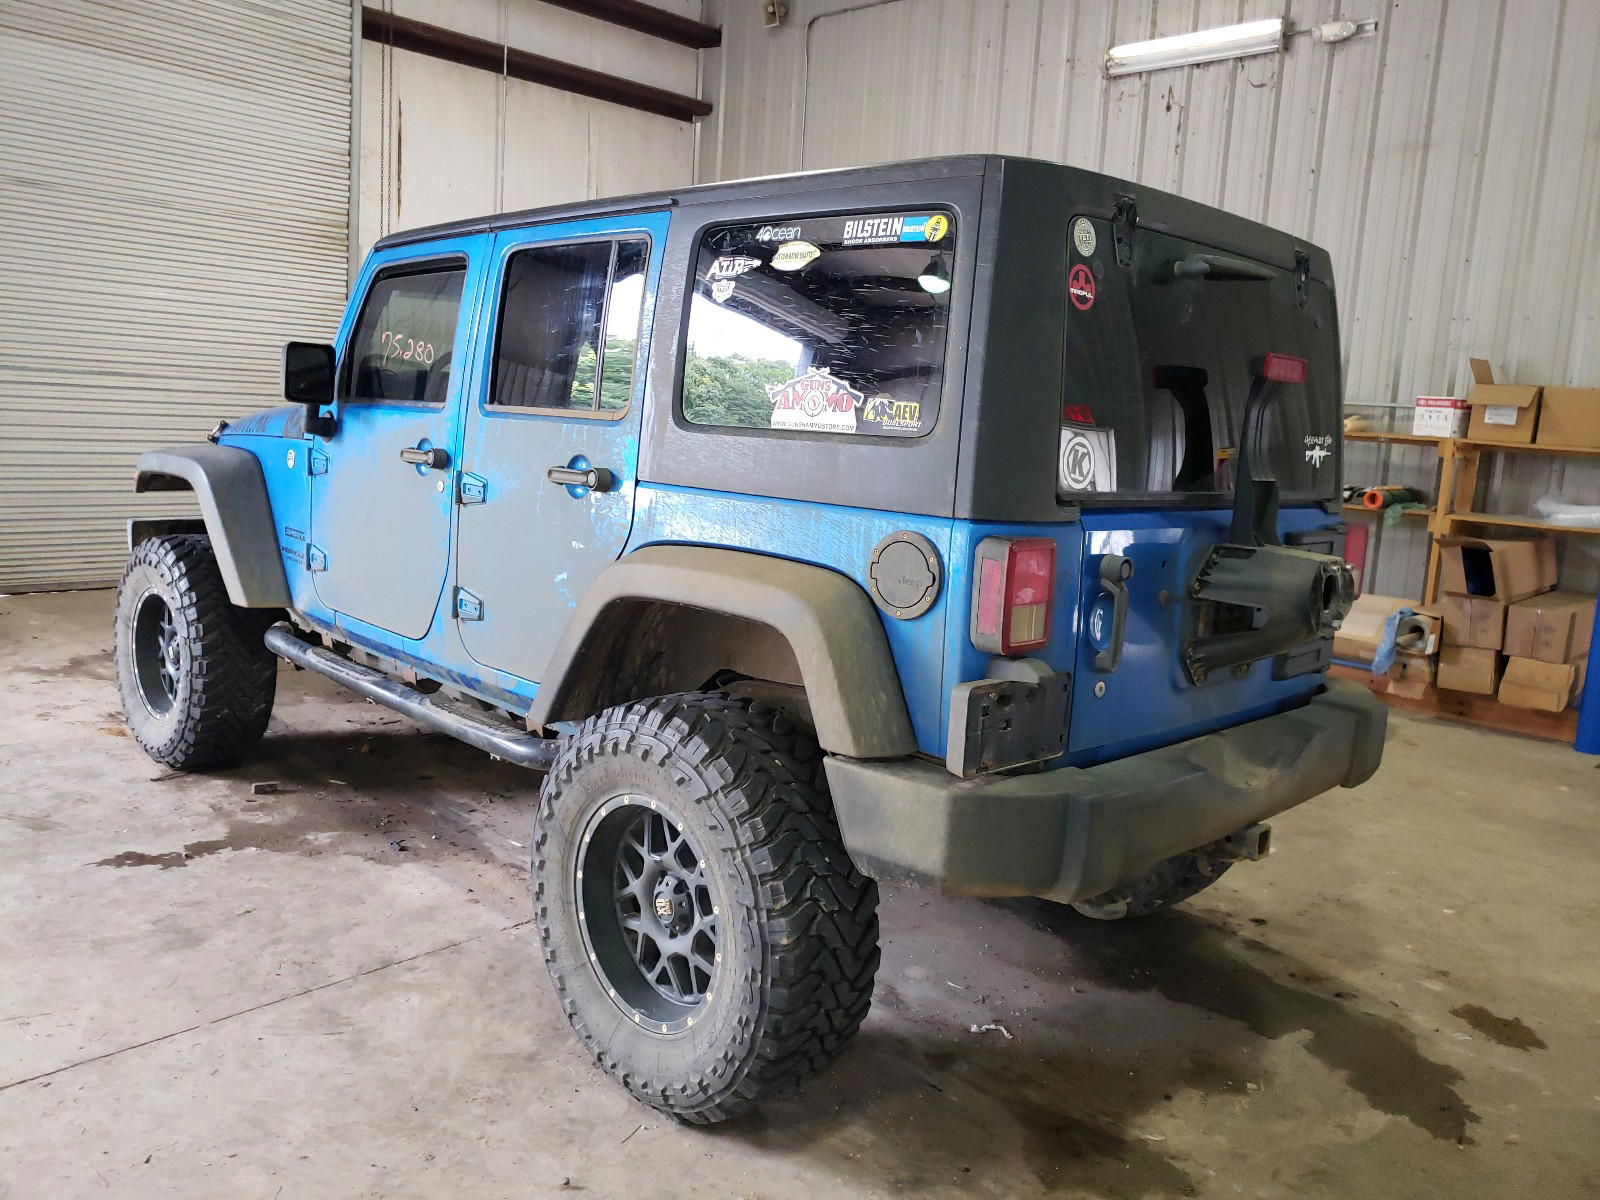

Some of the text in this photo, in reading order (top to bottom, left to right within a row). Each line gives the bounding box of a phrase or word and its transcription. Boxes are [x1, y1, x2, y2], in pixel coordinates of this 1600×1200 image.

[843, 217, 904, 238] BILSTEIN
[864, 236, 898, 244] ABSORBERS
[381, 331, 435, 366] 75,280
[800, 379, 832, 391] GUNS
[893, 403, 919, 421] AEV
